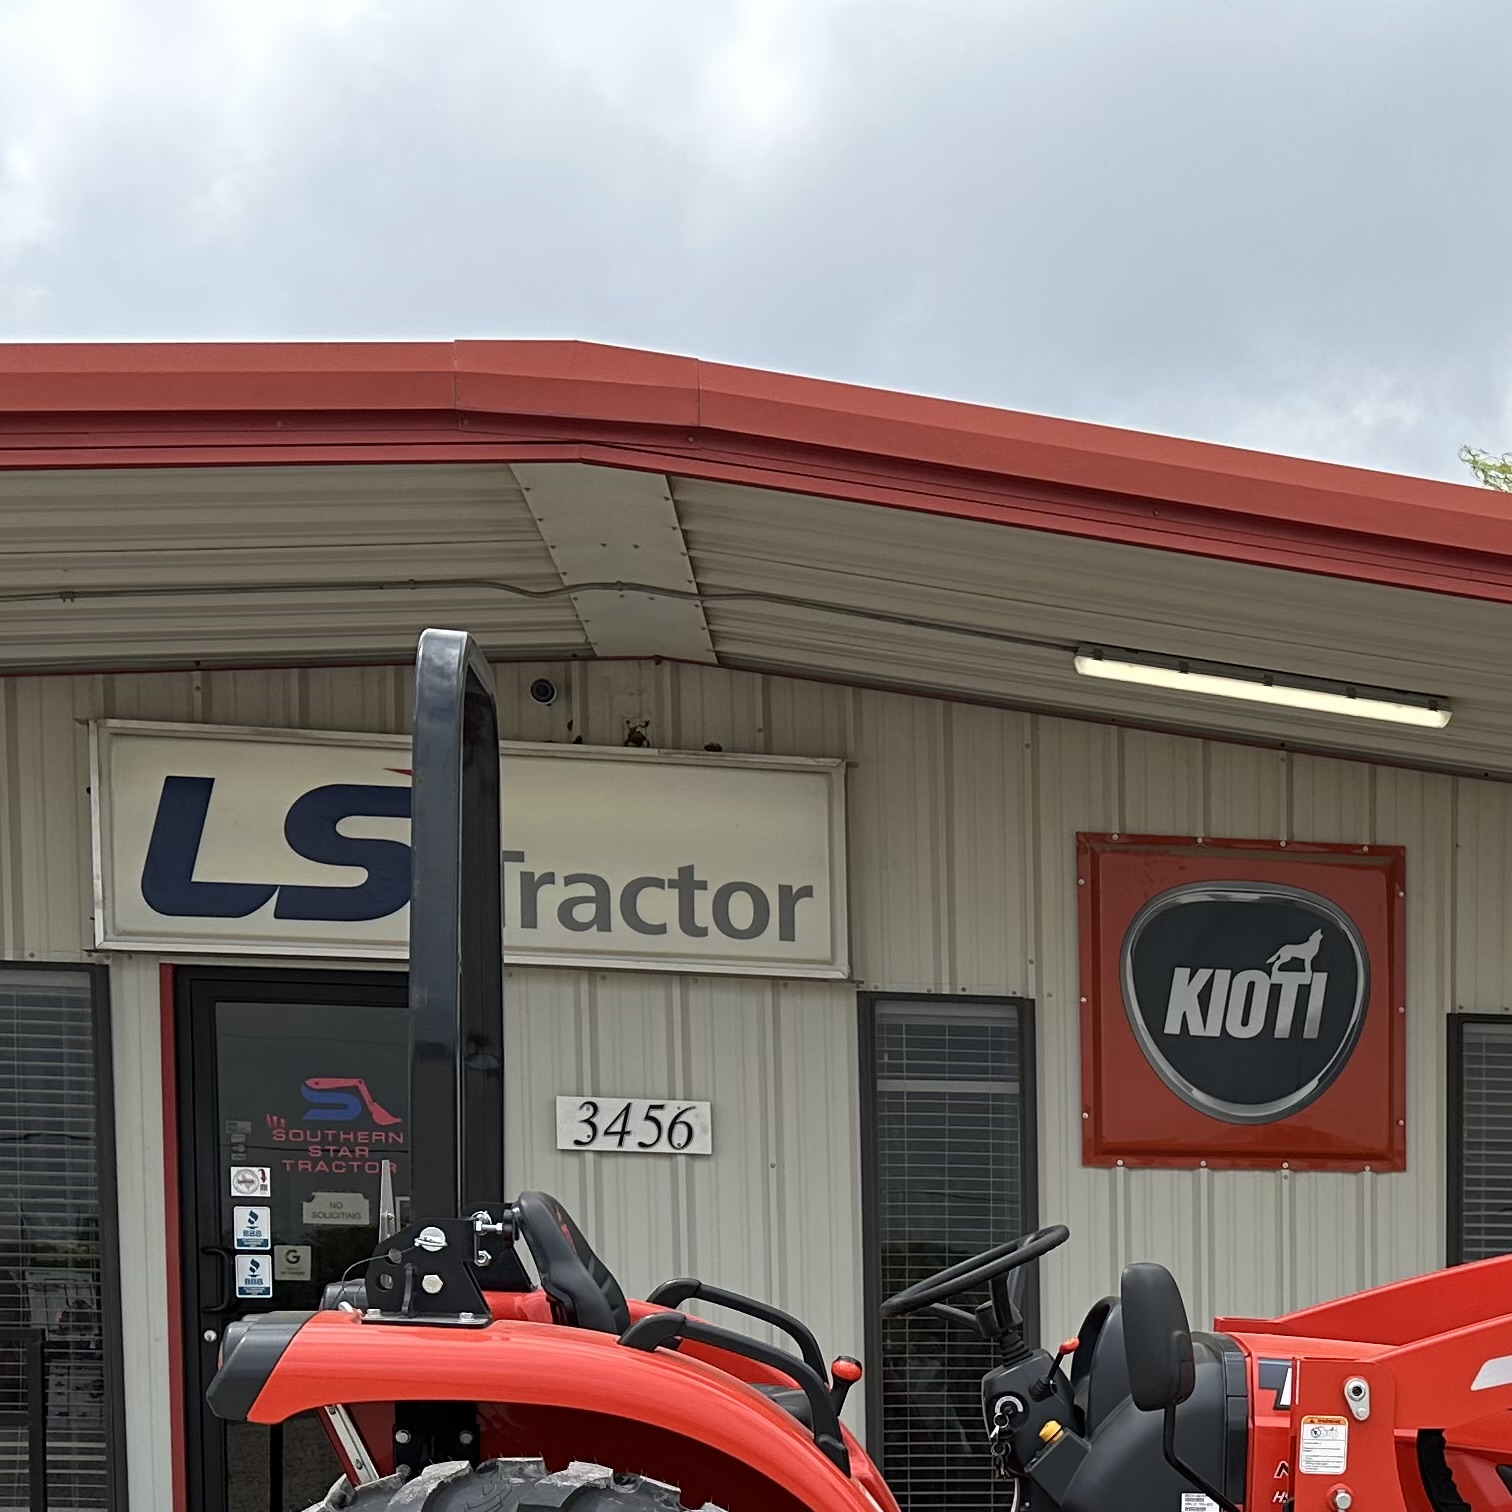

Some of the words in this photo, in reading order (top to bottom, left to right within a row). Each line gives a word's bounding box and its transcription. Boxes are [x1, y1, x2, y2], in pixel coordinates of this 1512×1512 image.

[140, 775, 412, 923] LS
[1163, 966, 1329, 1040] KIOTI
[572, 1100, 698, 1150] 3456
[272, 1128, 404, 1145] SOUTHERN
[308, 1145, 370, 1159] STAR
[329, 1201, 344, 1210] NO
[311, 1211, 362, 1221] SOLICITING
[285, 1249, 301, 1264] G
